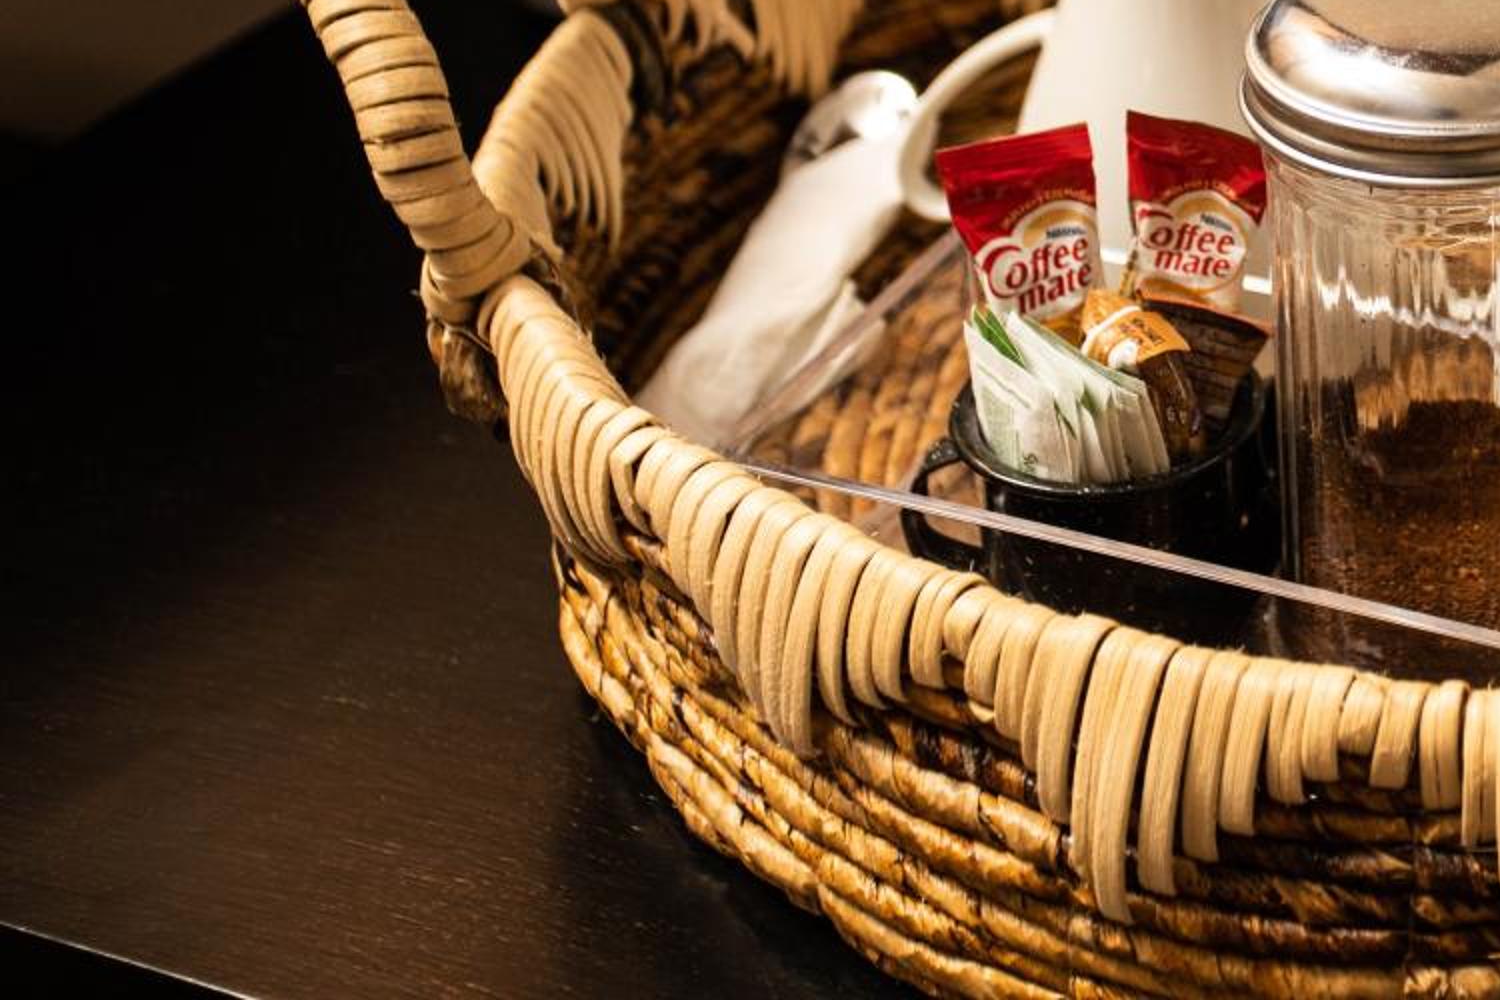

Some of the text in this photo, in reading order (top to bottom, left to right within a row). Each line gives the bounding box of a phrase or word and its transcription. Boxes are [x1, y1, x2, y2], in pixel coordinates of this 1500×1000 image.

[1138, 207, 1235, 254] Coffee
[982, 238, 1088, 299] Coffee
[1154, 250, 1231, 278] mate
[1018, 264, 1091, 314] mate
